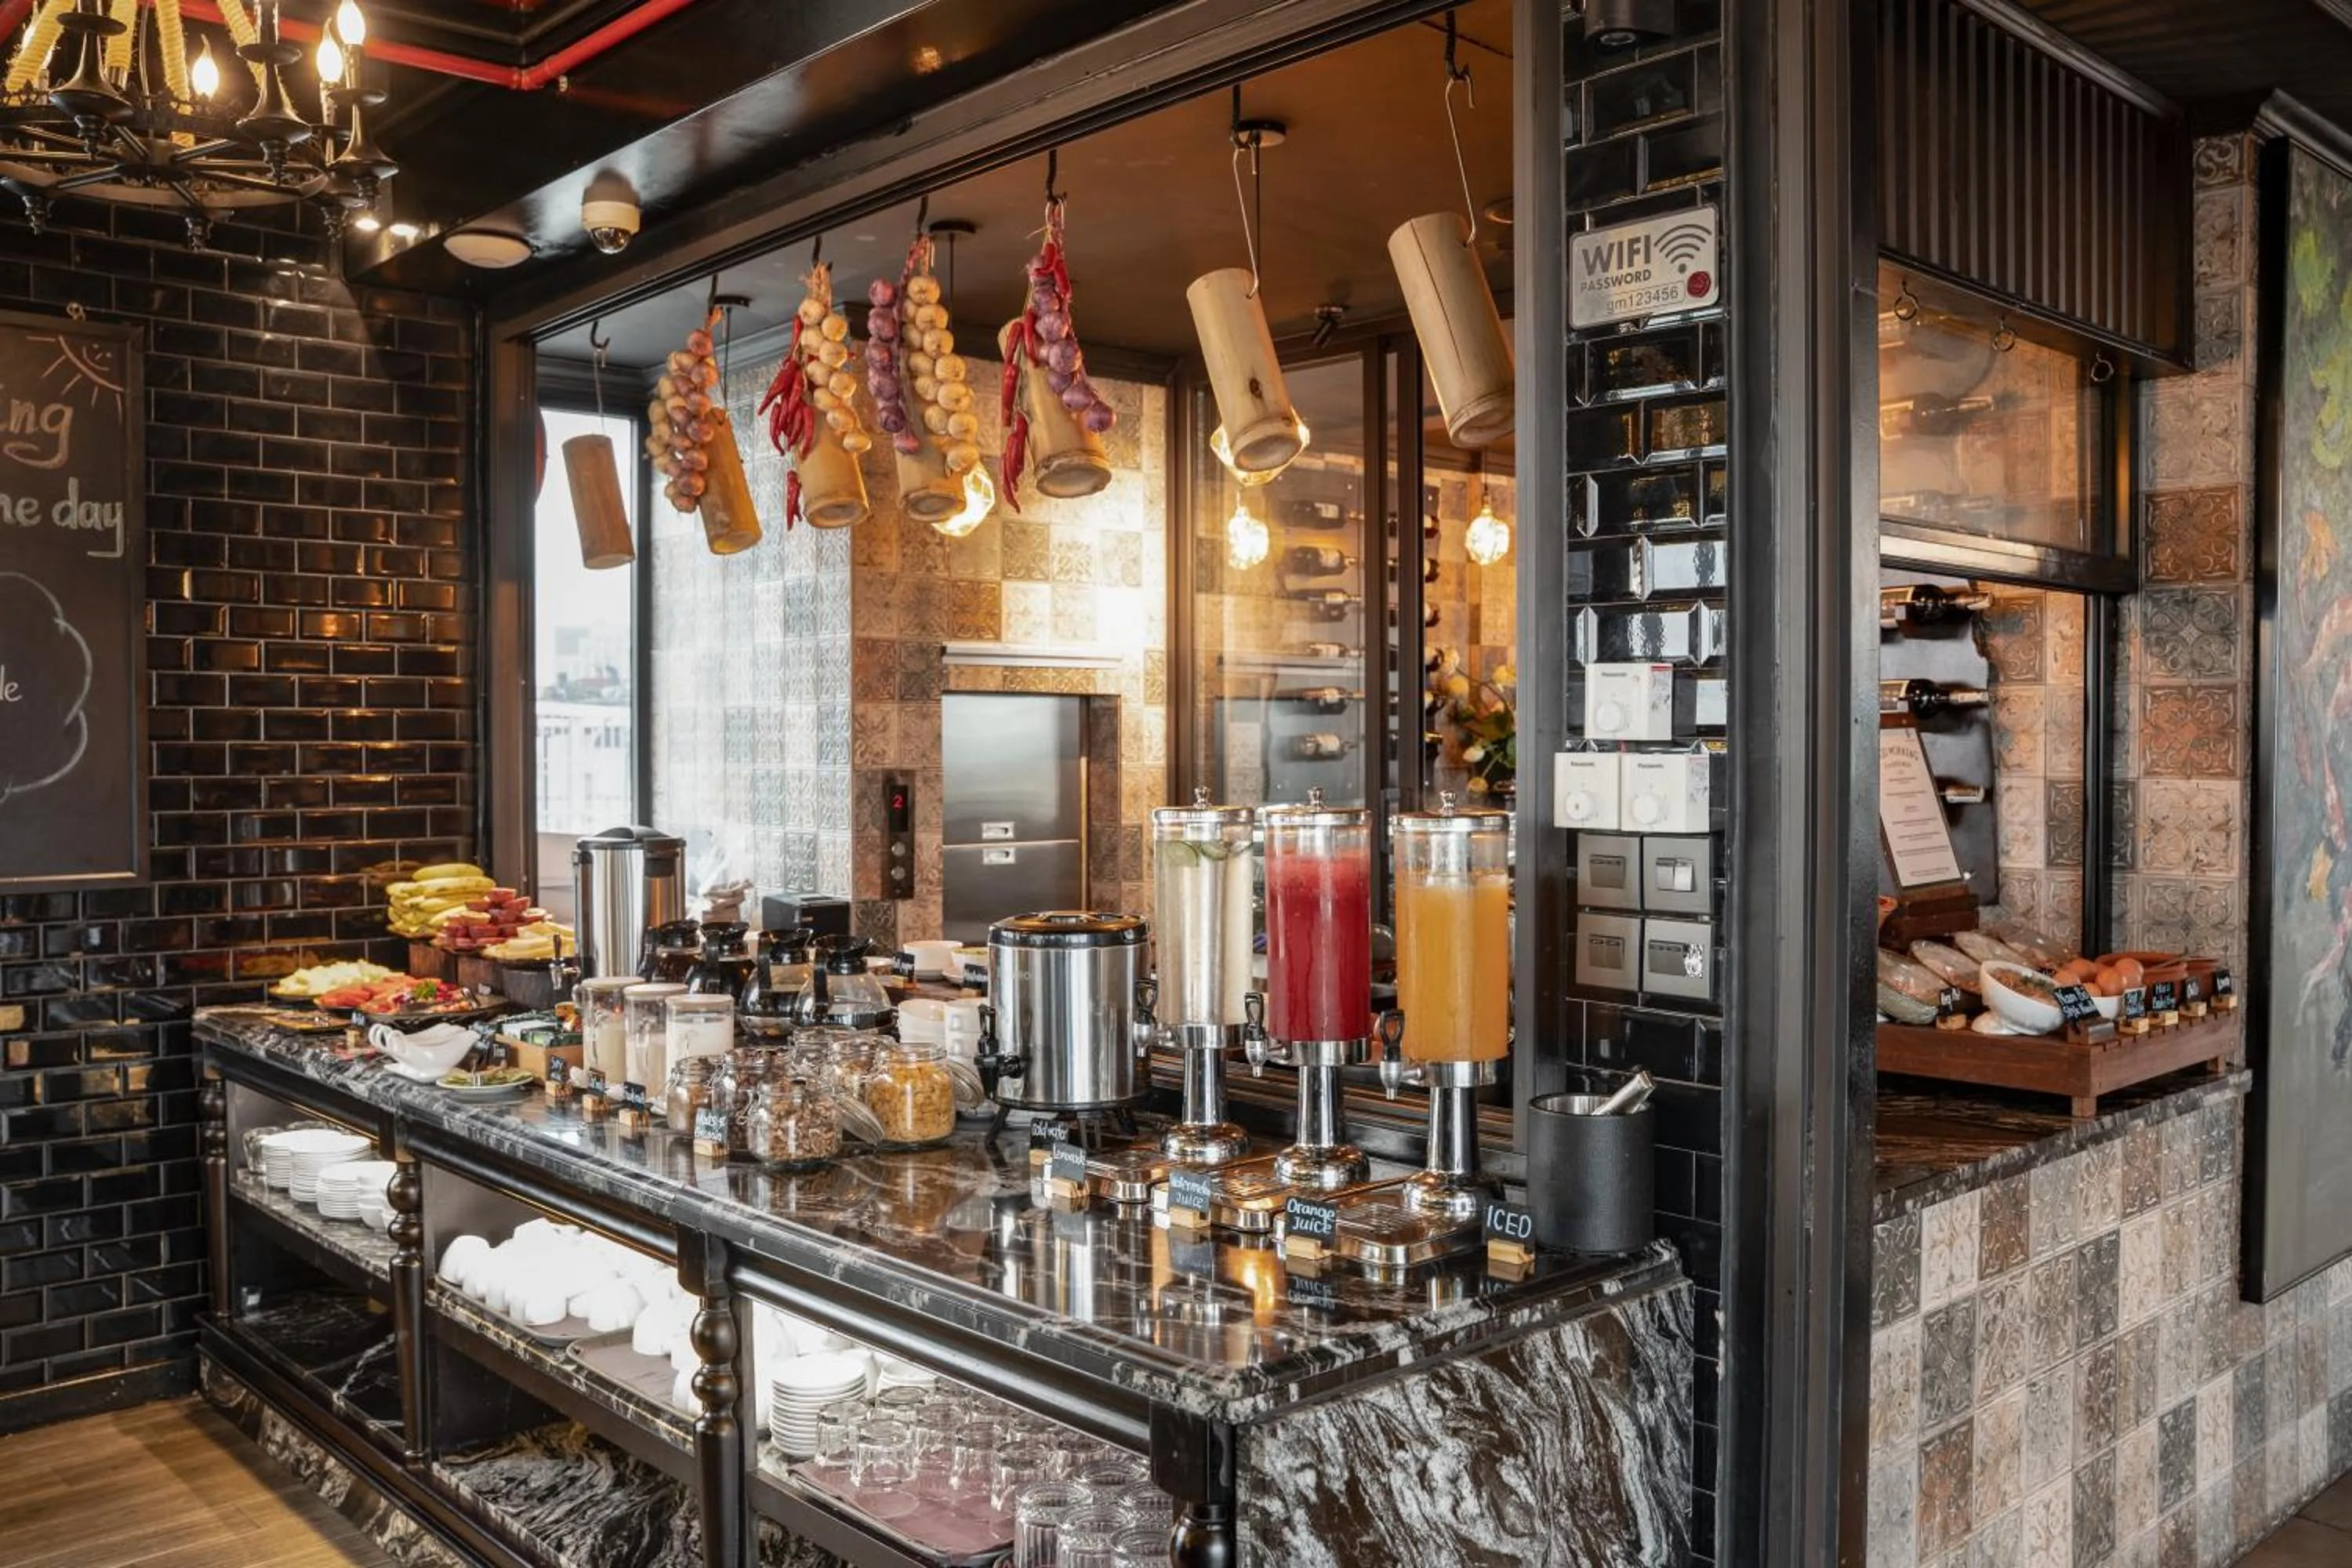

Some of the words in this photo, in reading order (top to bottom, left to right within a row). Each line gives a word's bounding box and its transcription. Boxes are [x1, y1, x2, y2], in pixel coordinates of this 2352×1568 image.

[1581, 235, 1651, 277] WIFI
[1581, 269, 1652, 293] PASSWORD
[1606, 285, 1679, 314] gm123456
[0, 384, 74, 469] ng
[51, 477, 125, 557] day
[892, 793, 903, 810] 2
[1287, 1197, 1335, 1224] Orange
[1486, 1205, 1531, 1238] ICED
